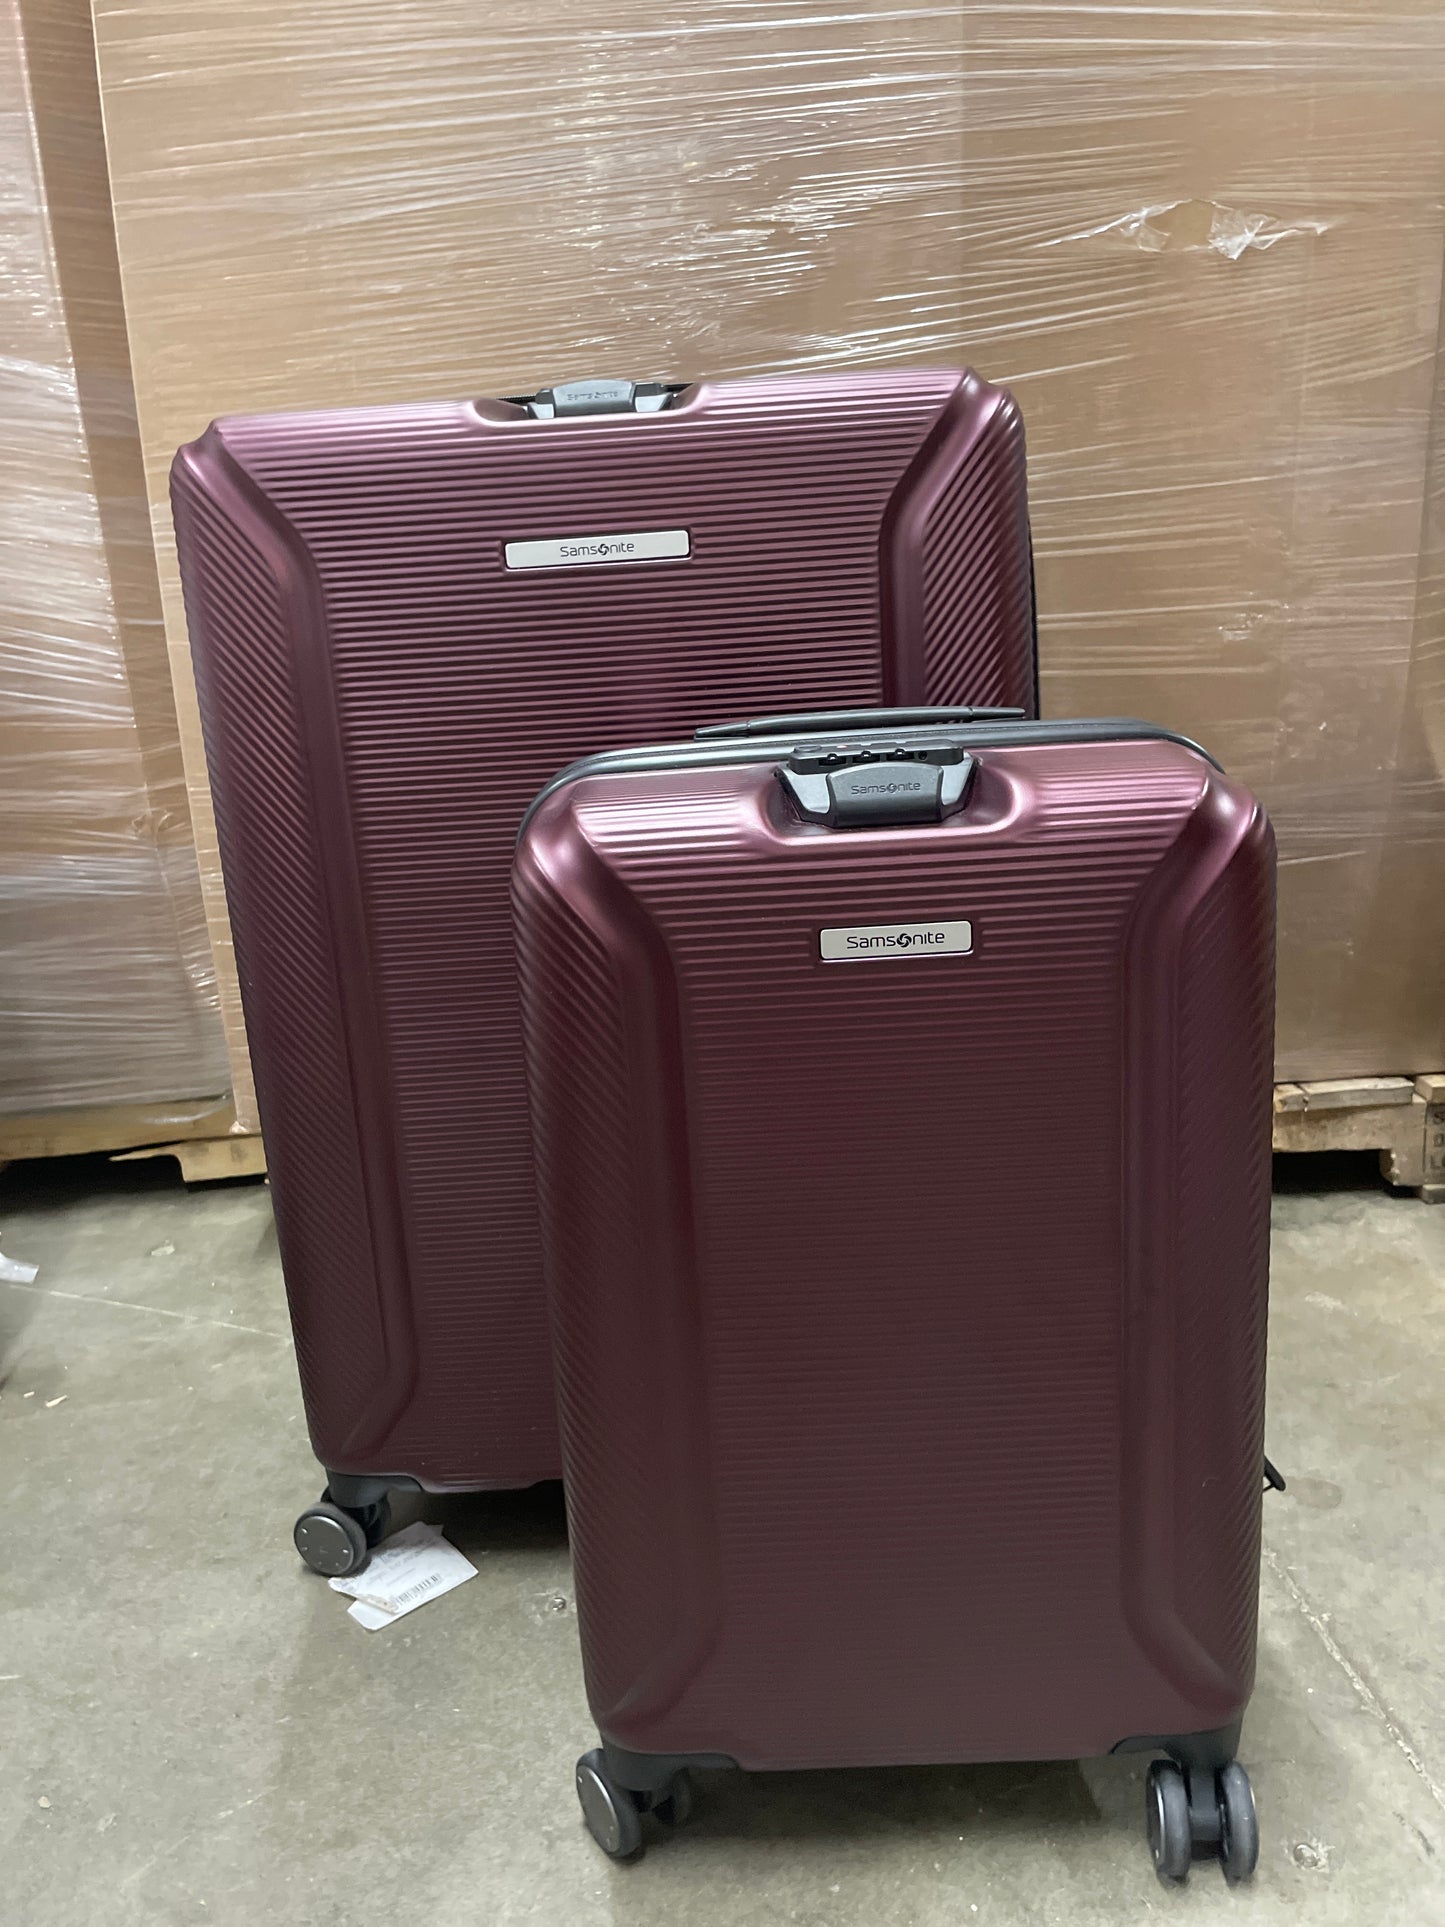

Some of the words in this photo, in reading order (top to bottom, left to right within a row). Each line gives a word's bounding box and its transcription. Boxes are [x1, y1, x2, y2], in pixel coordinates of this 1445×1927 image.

[560, 541, 635, 557] Samsonite
[850, 781, 921, 795] Samsonite
[846, 931, 946, 949] Samsonite
